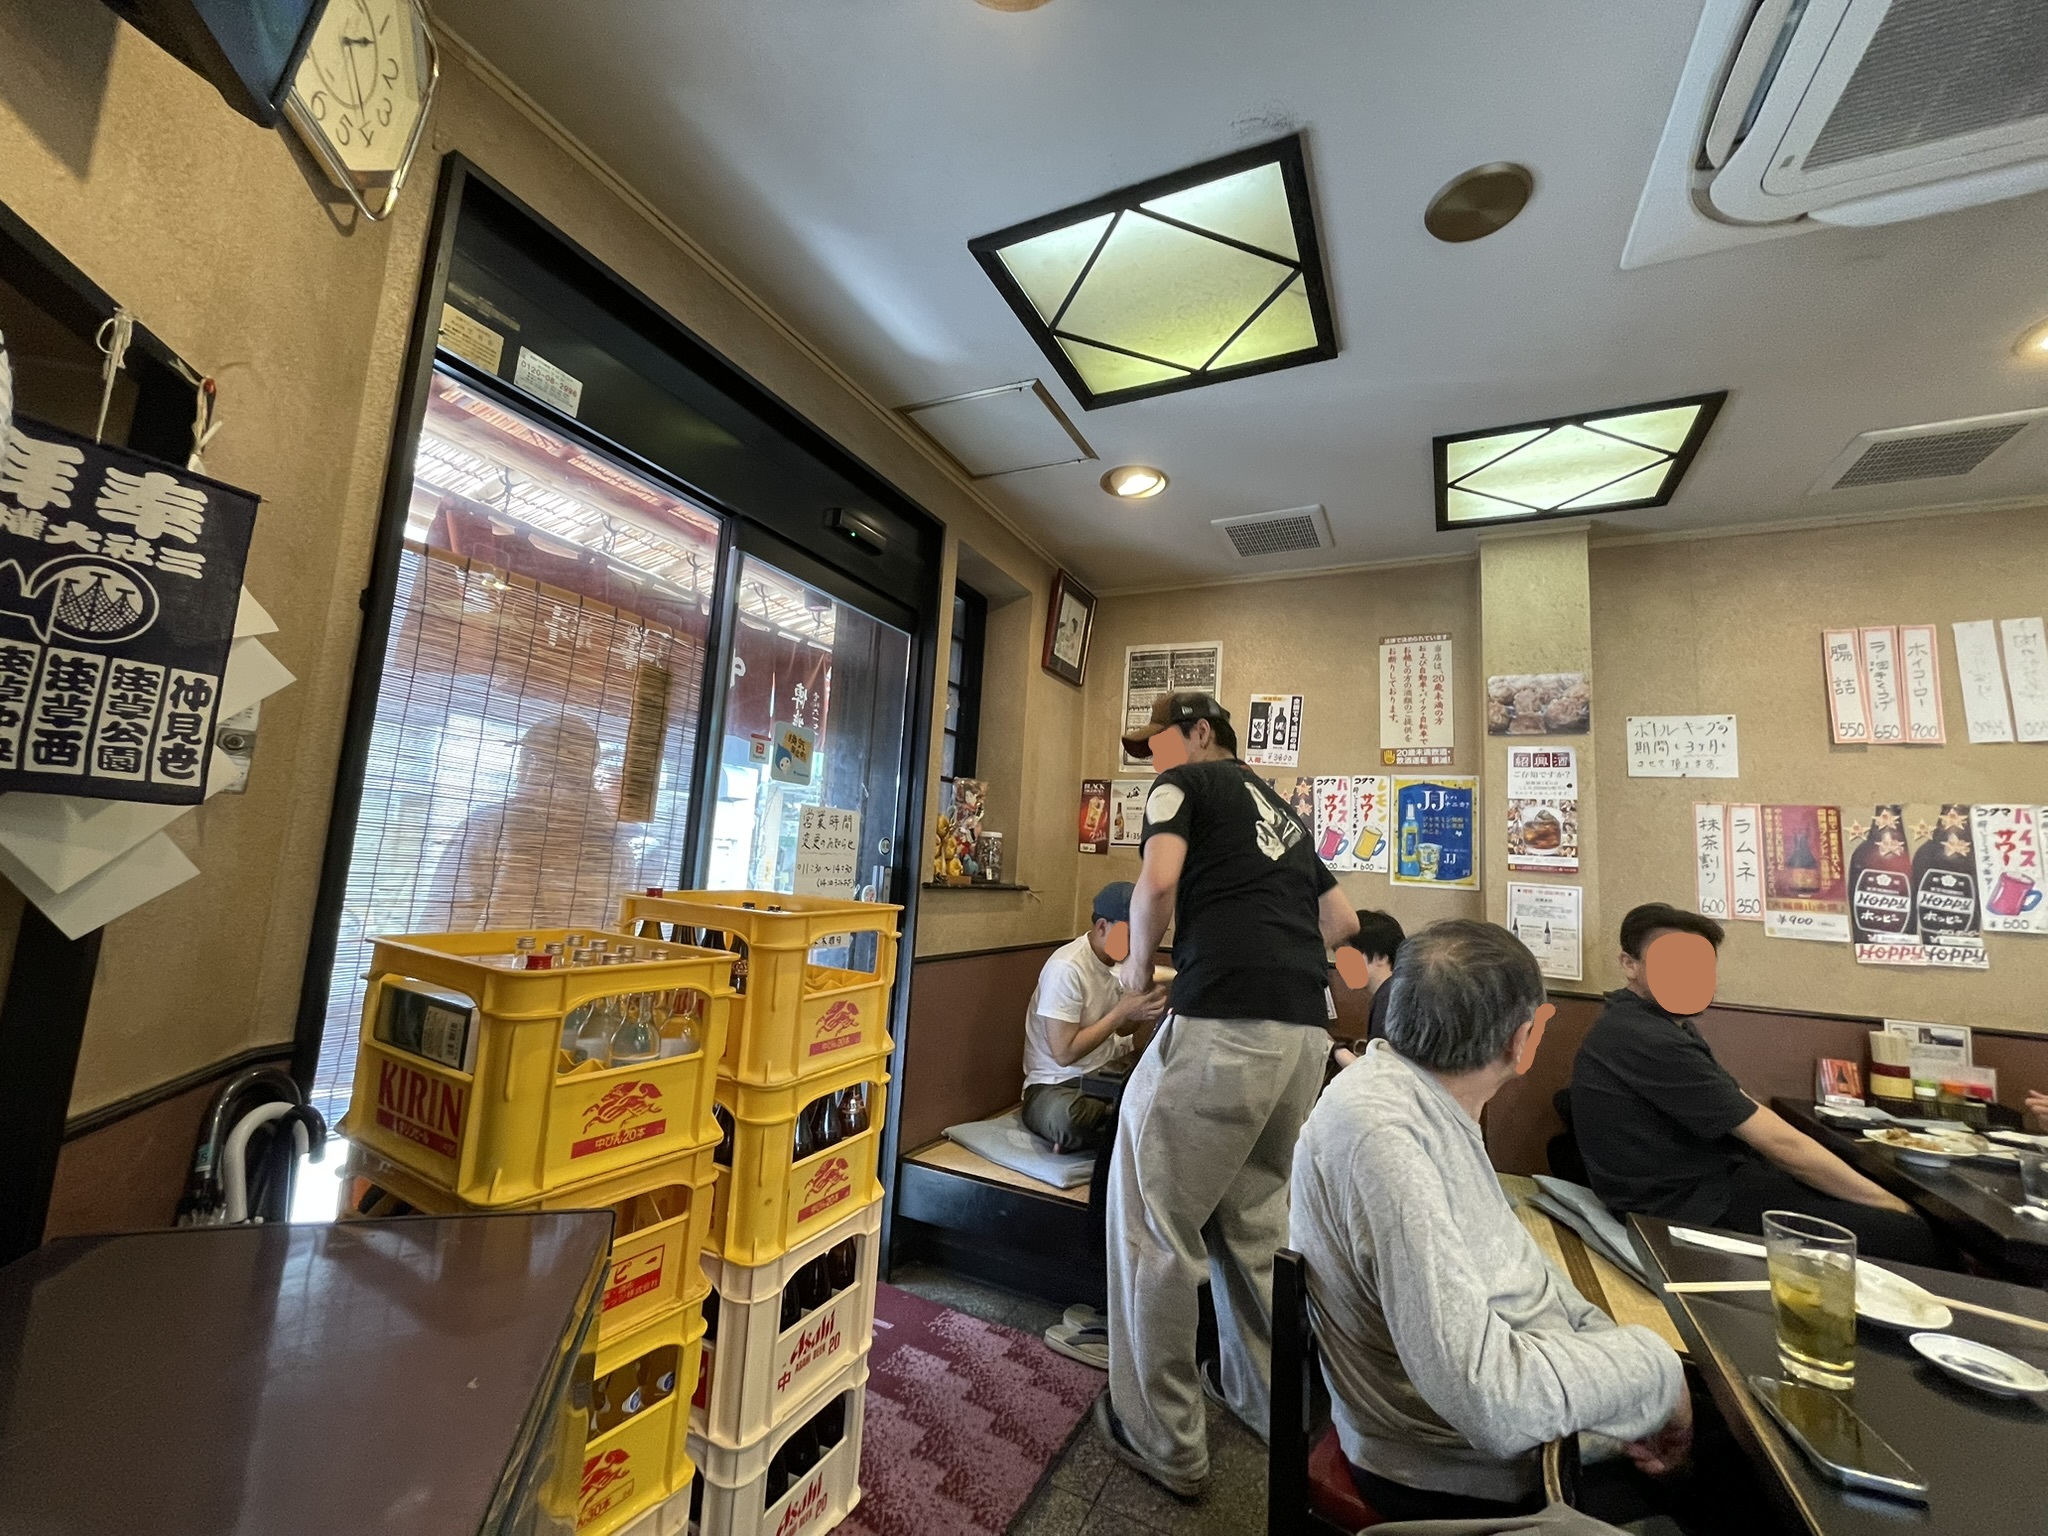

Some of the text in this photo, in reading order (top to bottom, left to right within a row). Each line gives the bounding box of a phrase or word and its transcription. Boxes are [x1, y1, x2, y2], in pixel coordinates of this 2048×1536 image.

[1839, 722, 1865, 737] 550
[1873, 723, 1900, 739] 650
[1911, 722, 1938, 738] 900
[1734, 818, 1756, 882] ラムネ
[1701, 898, 1726, 913] 600
[1736, 898, 1761, 914] 350
[377, 1058, 465, 1138] KIRIN
[789, 1307, 836, 1365] Asahi
[827, 1331, 841, 1356] 20
[777, 1370, 791, 1392] 中
[815, 1492, 828, 1519] 20
